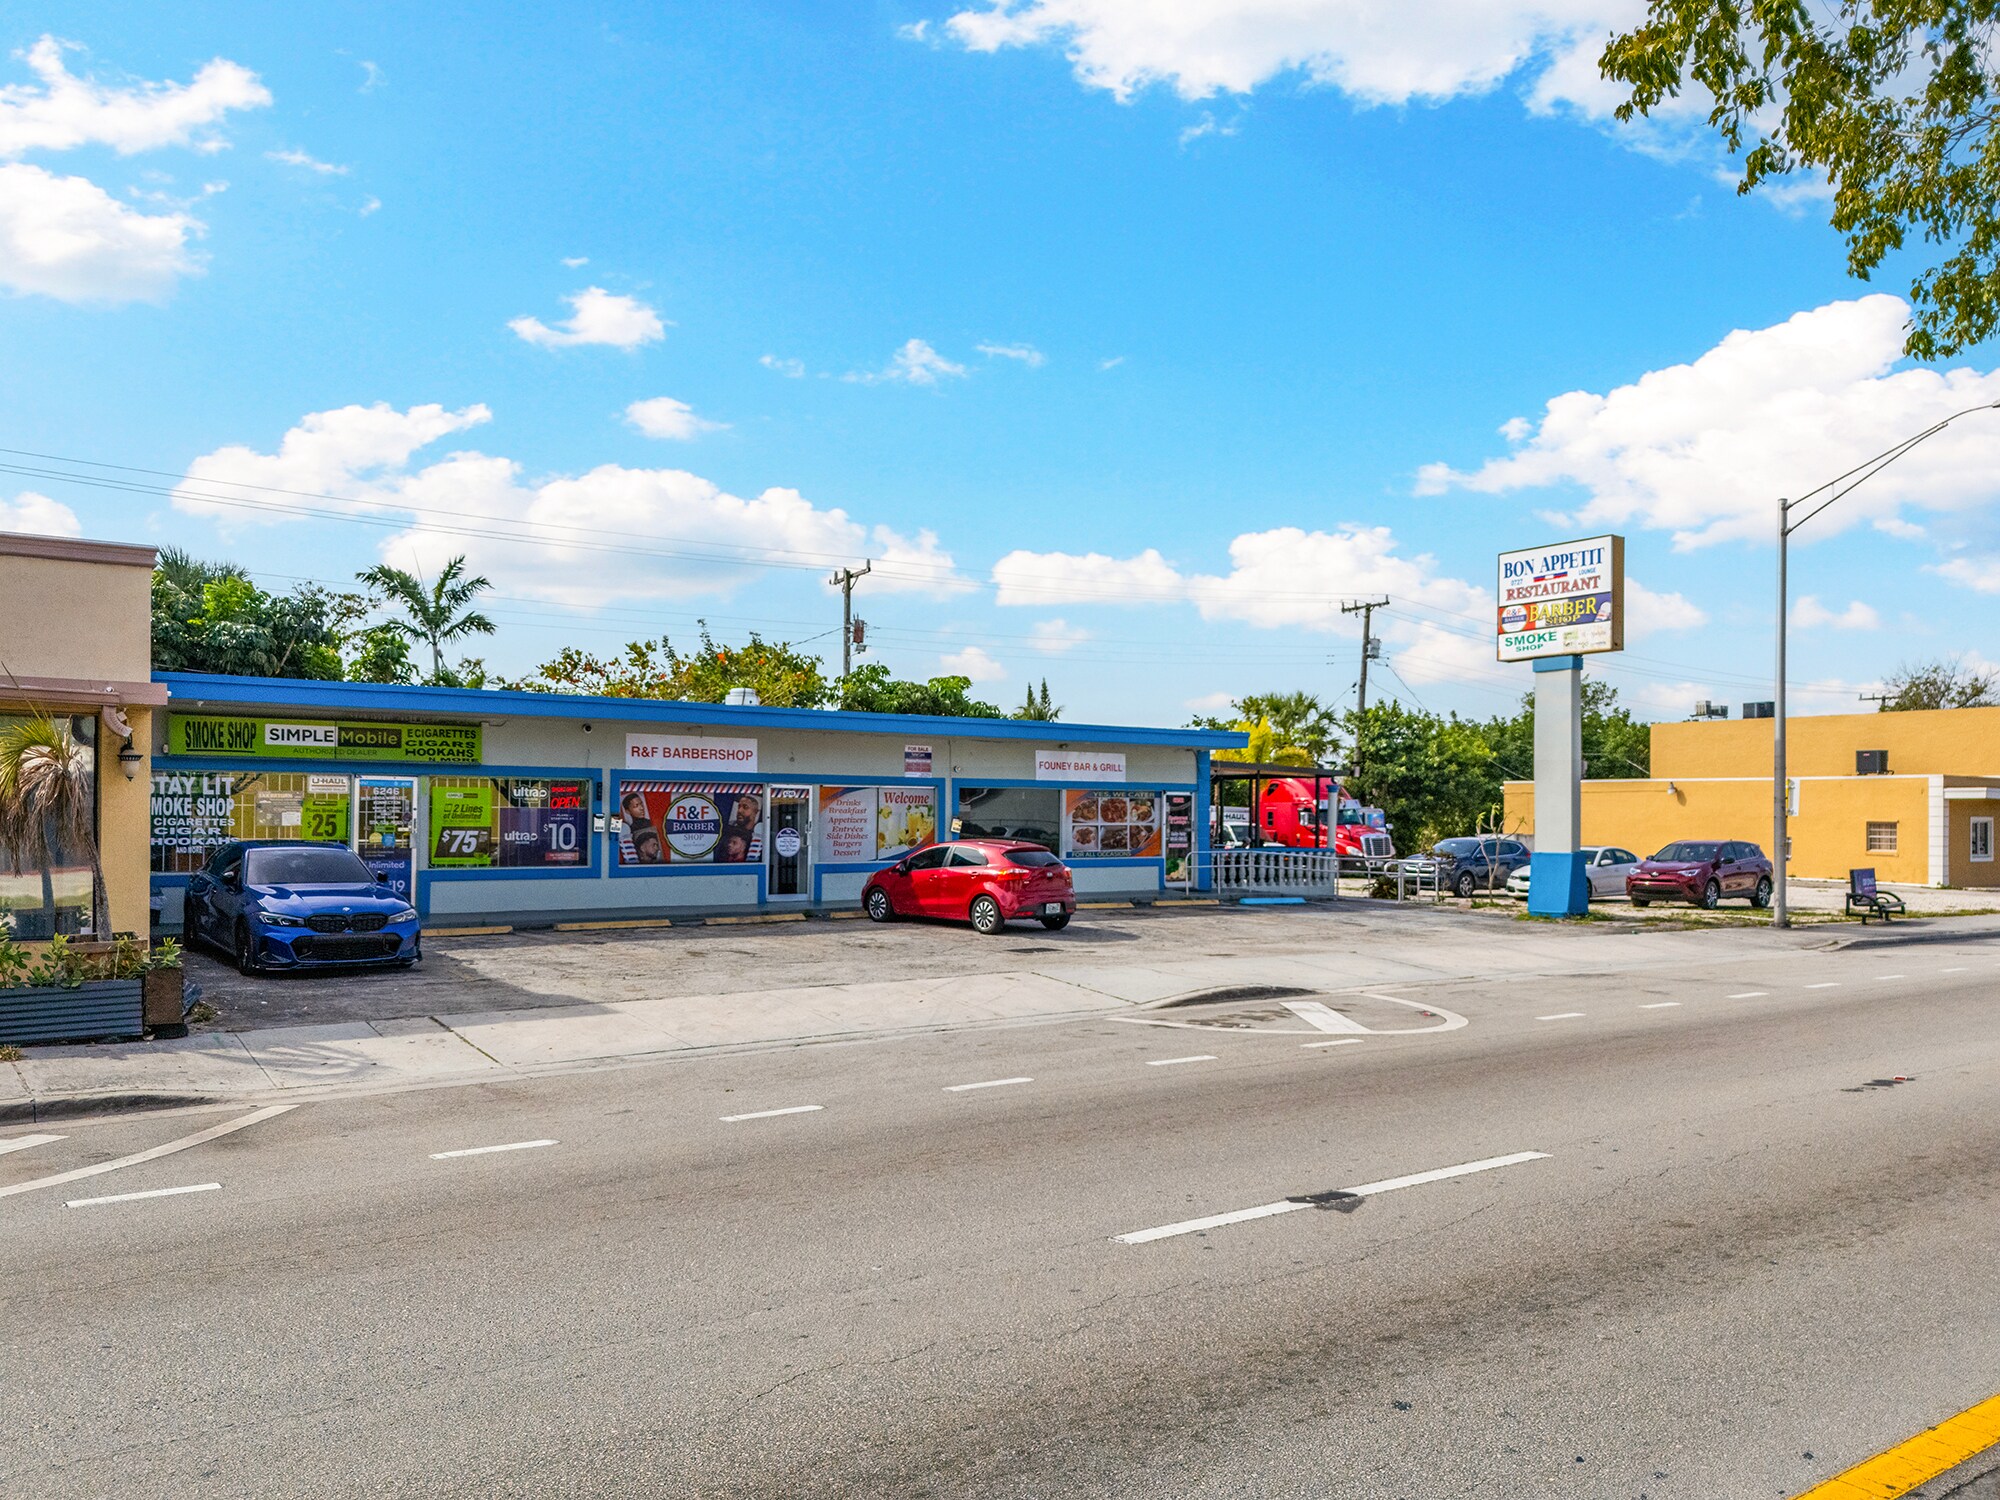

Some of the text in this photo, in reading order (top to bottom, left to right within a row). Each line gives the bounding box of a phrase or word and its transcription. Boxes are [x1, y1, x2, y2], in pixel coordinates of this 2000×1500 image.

[1503, 547, 1605, 579] BON APPETIT
[1505, 575, 1601, 602] RESTAURANT
[1529, 597, 1598, 623] BARBER
[1545, 614, 1581, 627] SHOP
[1505, 631, 1557, 647] SMOKE
[1516, 643, 1543, 652] SHOP
[185, 721, 257, 749] SMOKE SHOP
[269, 728, 398, 745] SIMPLE Mobile
[405, 740, 476, 749] CIGARS
[405, 748, 474, 758] HOOKAHS
[631, 746, 753, 761] R&F BARBERSHOP
[1038, 761, 1123, 772] FOUNEY BAR & GRILL
[203, 777, 235, 796] LIT
[373, 787, 400, 796] 6246
[550, 796, 581, 809] OPEN
[884, 791, 930, 804] Welcome
[151, 796, 192, 816] MOKE
[196, 797, 235, 816] SHOP
[453, 804, 483, 813] 2 Lines
[676, 805, 710, 819] R&F
[828, 807, 867, 815] Breakfast
[153, 817, 235, 826] CIGARETTES
[307, 813, 337, 837] $25
[673, 822, 715, 832] BARBER
[828, 817, 868, 825] Appetizers
[153, 827, 222, 835] CIGAR
[832, 825, 864, 833] Entrées
[441, 829, 479, 853] $75
[543, 823, 577, 850] $10
[684, 833, 704, 841] SHOP
[826, 832, 843, 840] Side
[832, 840, 862, 848] Burgers
[833, 849, 861, 857] Dessert
